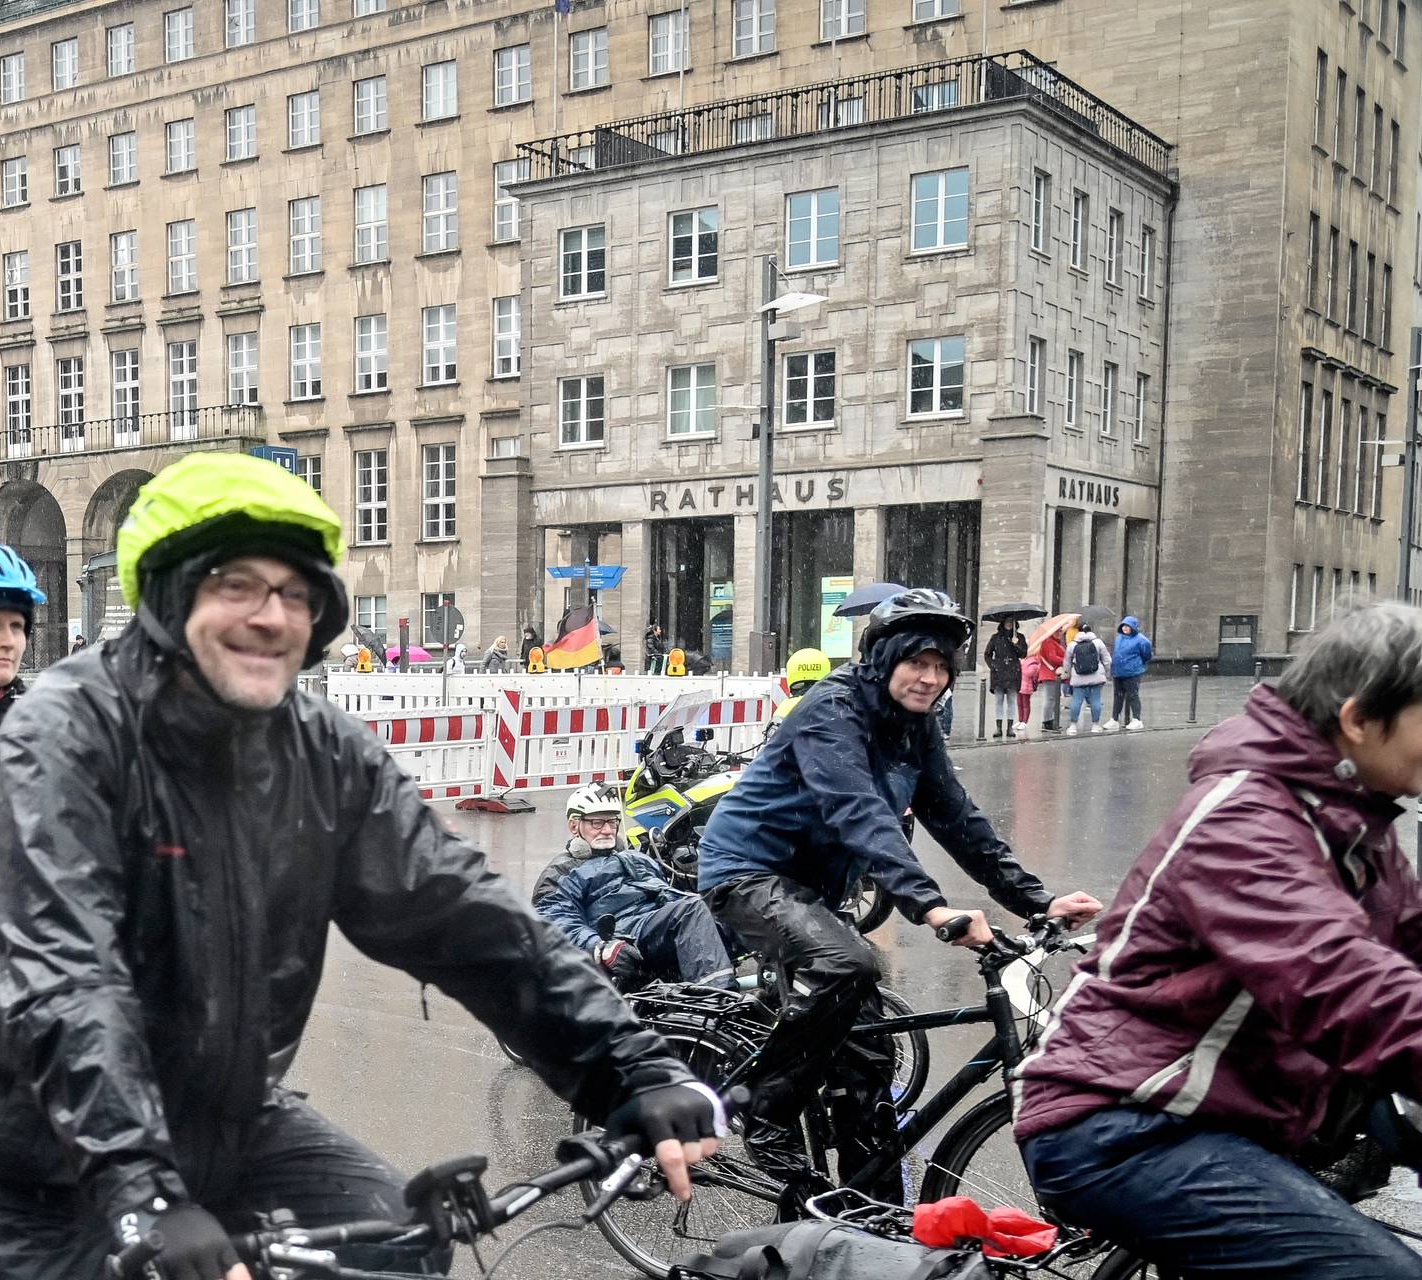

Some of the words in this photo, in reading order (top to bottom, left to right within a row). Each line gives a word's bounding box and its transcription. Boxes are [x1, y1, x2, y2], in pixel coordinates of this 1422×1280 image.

[650, 478, 844, 512] RATHAUS
[1058, 476, 1120, 507] RATHAUS
[797, 663, 822, 672] POLIZEI
